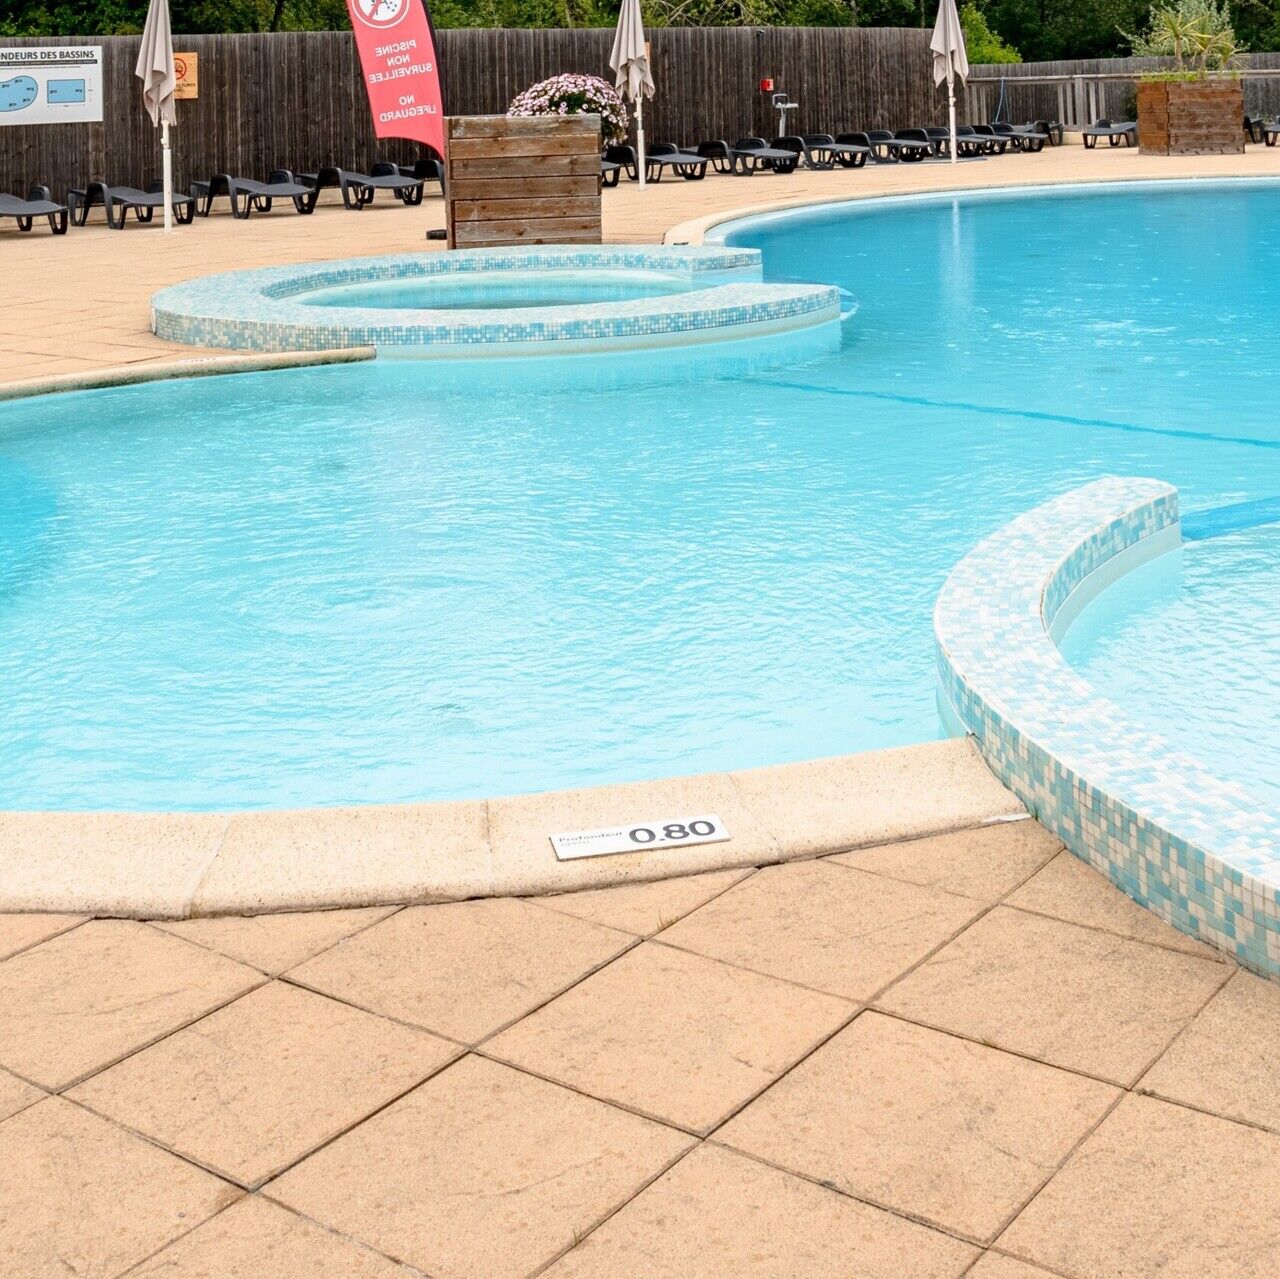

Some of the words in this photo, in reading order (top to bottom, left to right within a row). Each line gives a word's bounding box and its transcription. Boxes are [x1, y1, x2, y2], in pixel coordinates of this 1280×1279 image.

[40, 51, 58, 60] DES
[59, 50, 95, 59] BASSINS
[559, 831, 623, 842] Profondeur
[628, 820, 716, 844] 0.80
